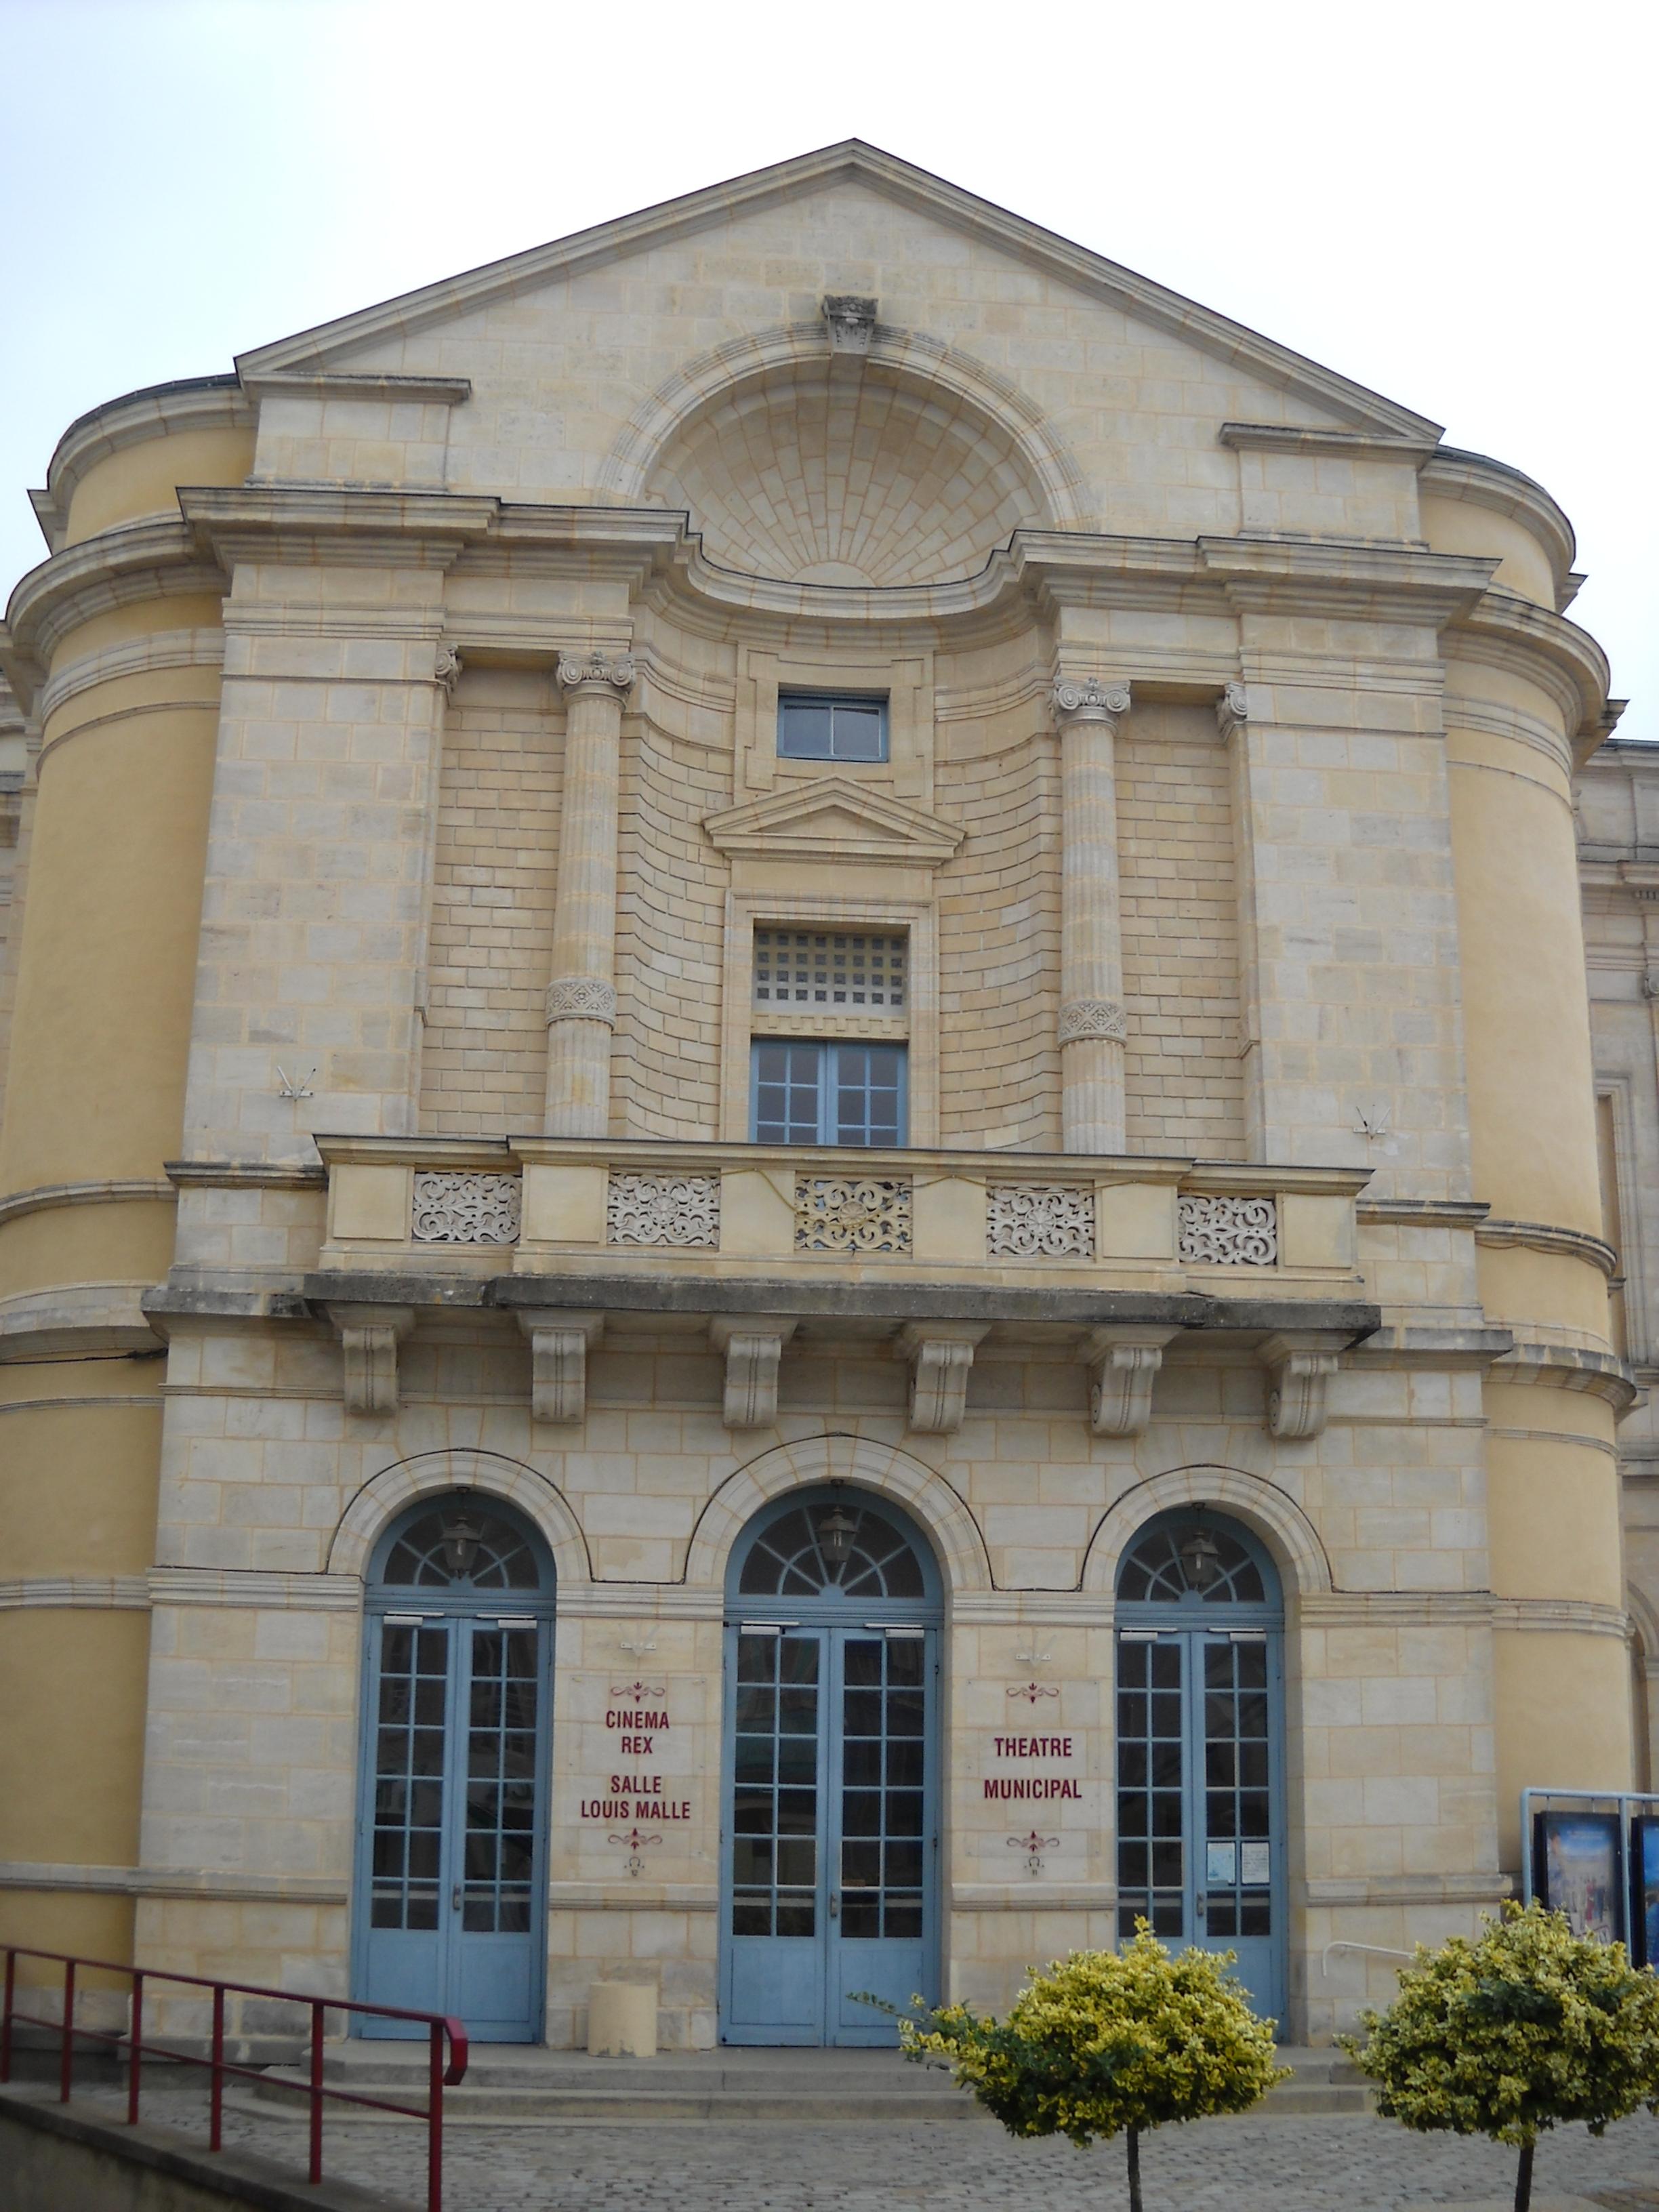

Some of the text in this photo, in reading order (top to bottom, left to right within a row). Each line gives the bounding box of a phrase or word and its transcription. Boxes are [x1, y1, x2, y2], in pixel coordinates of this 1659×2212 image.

[606, 1711, 670, 1729] CINEMA
[621, 1736, 653, 1754] REX
[994, 1738, 1072, 1757] THEATRE
[611, 1776, 661, 1793] SALLE
[985, 1779, 1082, 1799] MUNICIPAL
[581, 1800, 691, 1819] LOUIS MALLE
